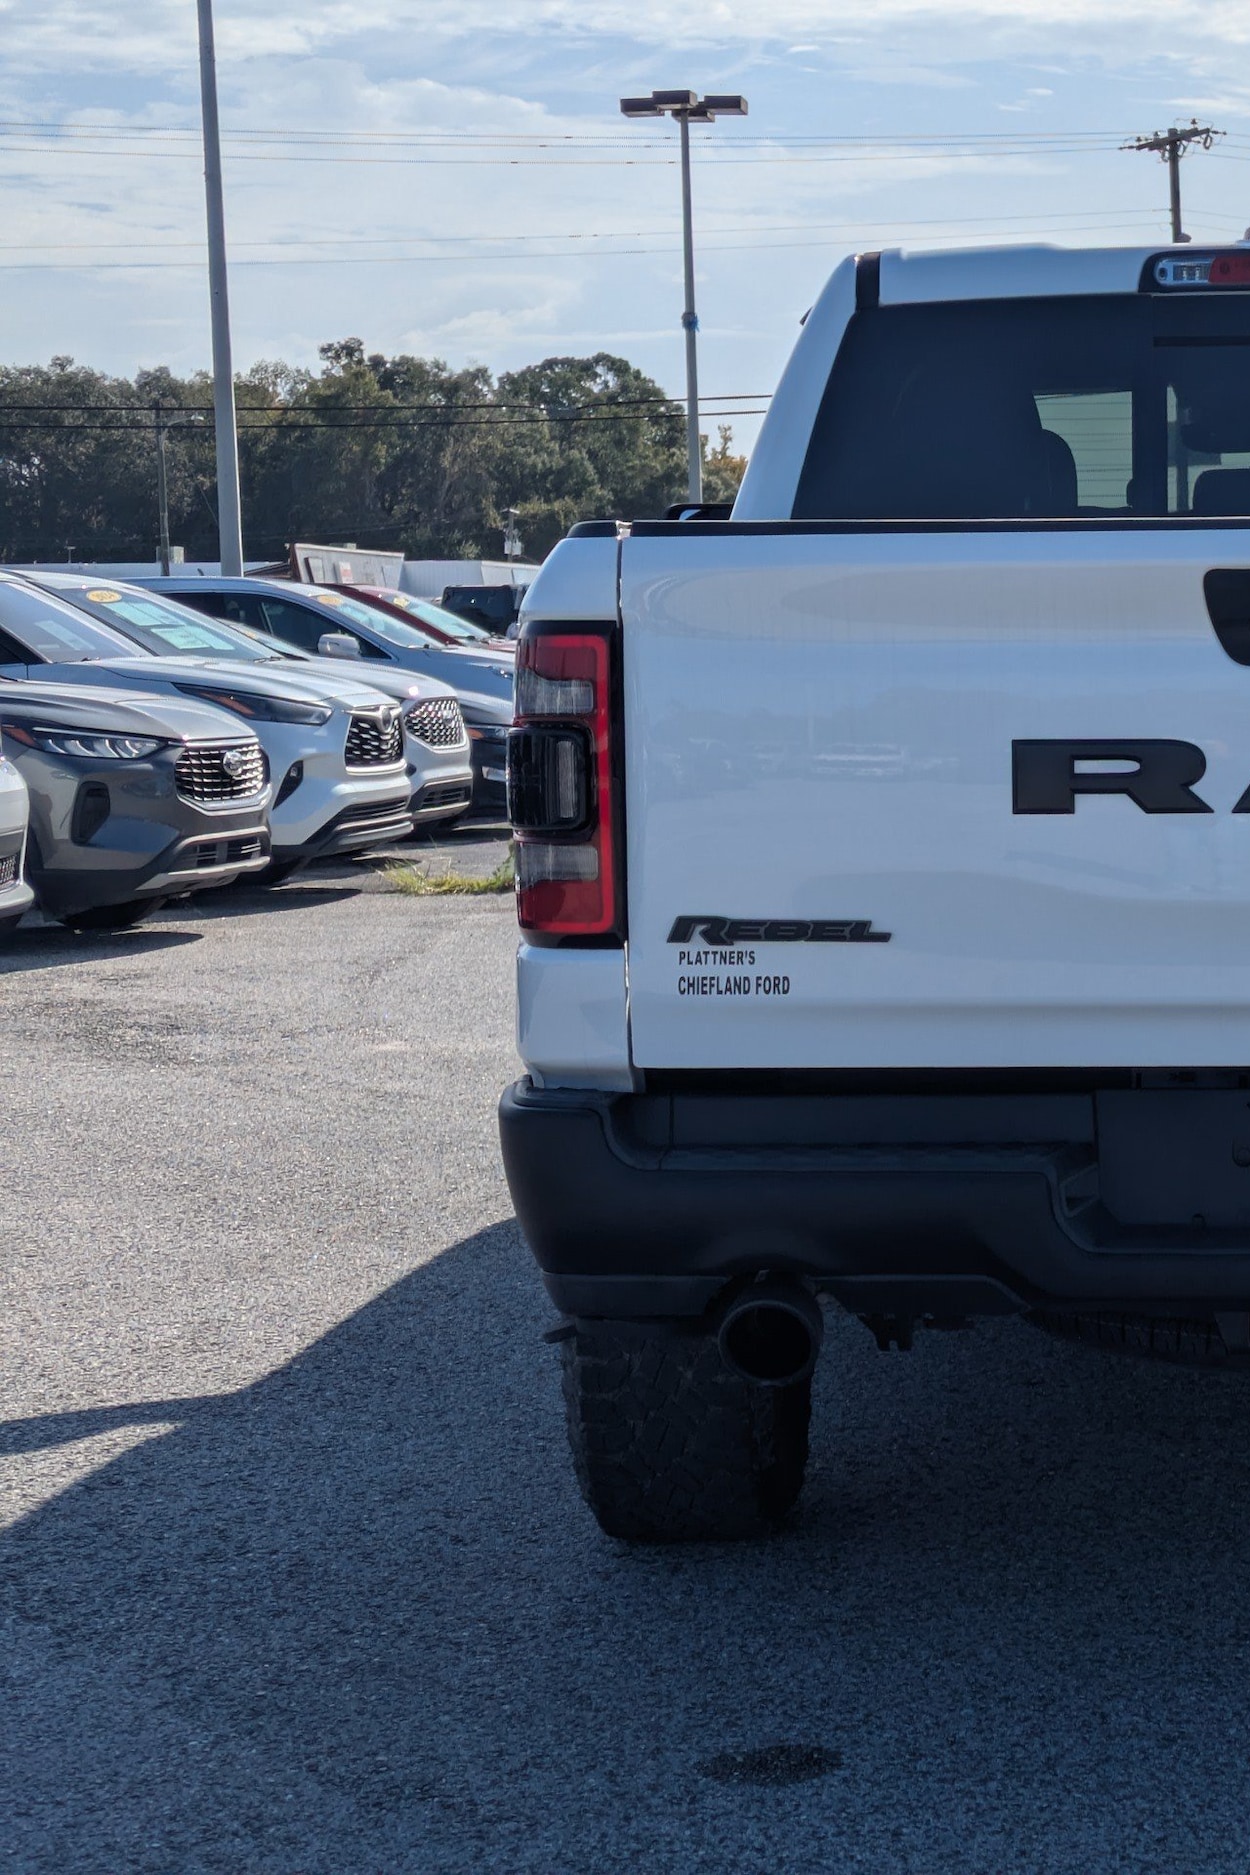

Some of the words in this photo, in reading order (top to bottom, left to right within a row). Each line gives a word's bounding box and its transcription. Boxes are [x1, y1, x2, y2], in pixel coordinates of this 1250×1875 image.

[666, 915, 892, 946] REBEL
[678, 950, 756, 966] PLATTNER'S
[677, 975, 751, 996] CHIEFLAND
[755, 975, 791, 996] FORD
